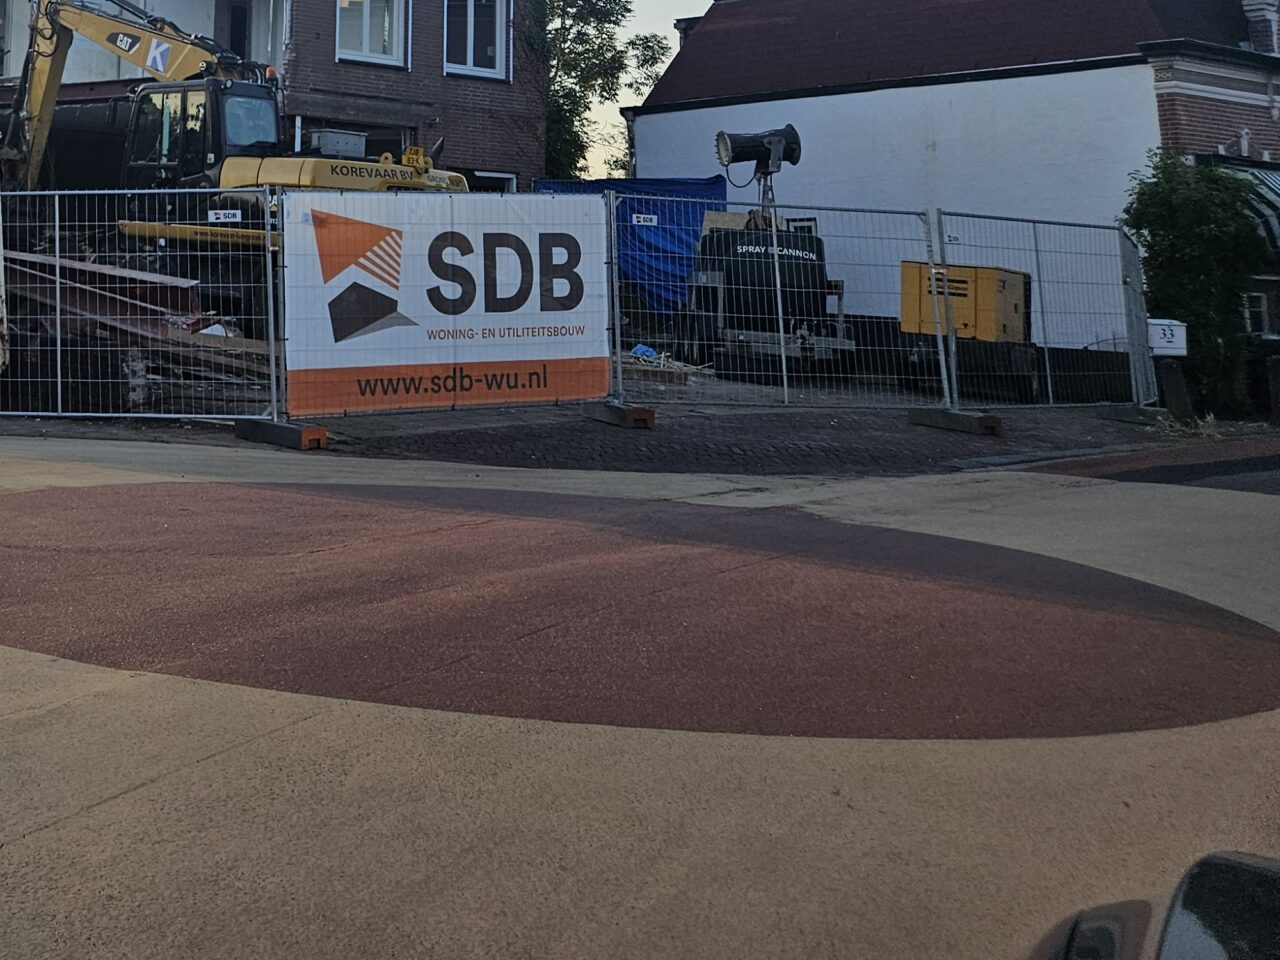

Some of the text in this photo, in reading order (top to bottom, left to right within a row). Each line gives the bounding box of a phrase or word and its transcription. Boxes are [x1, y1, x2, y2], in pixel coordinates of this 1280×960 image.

[117, 34, 132, 51] CAT
[331, 165, 398, 180] KOREVAAR
[400, 170, 413, 181] BV
[223, 212, 237, 220] SDB
[777, 247, 816, 260] CANNON
[426, 231, 584, 315] SDB
[427, 325, 585, 340] WONING- EN UTILITEITSBOUW
[1160, 328, 1174, 340] 33
[357, 364, 548, 397] www.sdb-wu.nl
